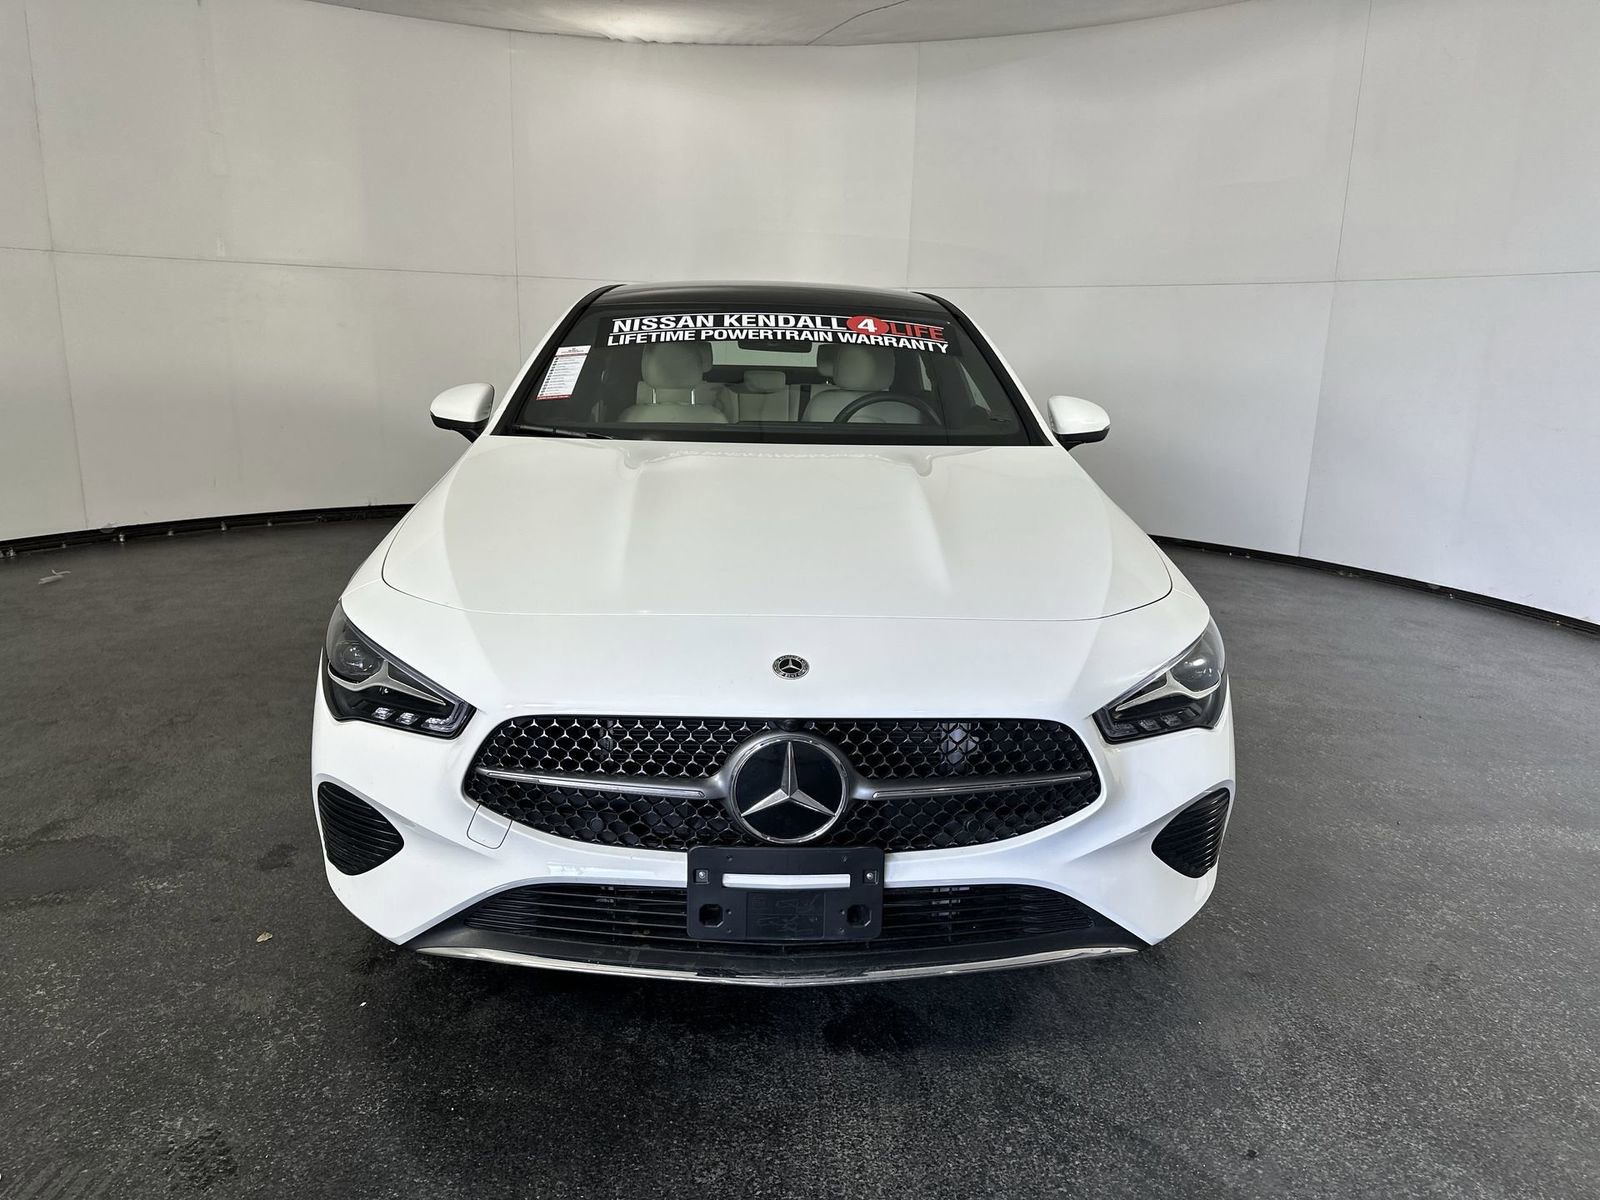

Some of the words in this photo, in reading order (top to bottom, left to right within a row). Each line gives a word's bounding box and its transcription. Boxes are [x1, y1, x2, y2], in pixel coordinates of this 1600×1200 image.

[613, 315, 714, 333] NISSAN
[723, 314, 847, 330] KENDALL
[857, 318, 878, 333] 4
[889, 321, 945, 340] LIFE
[607, 330, 696, 346] LIFETIME
[700, 329, 833, 342] POWERTRAIN
[837, 332, 949, 354] WARRANTY
